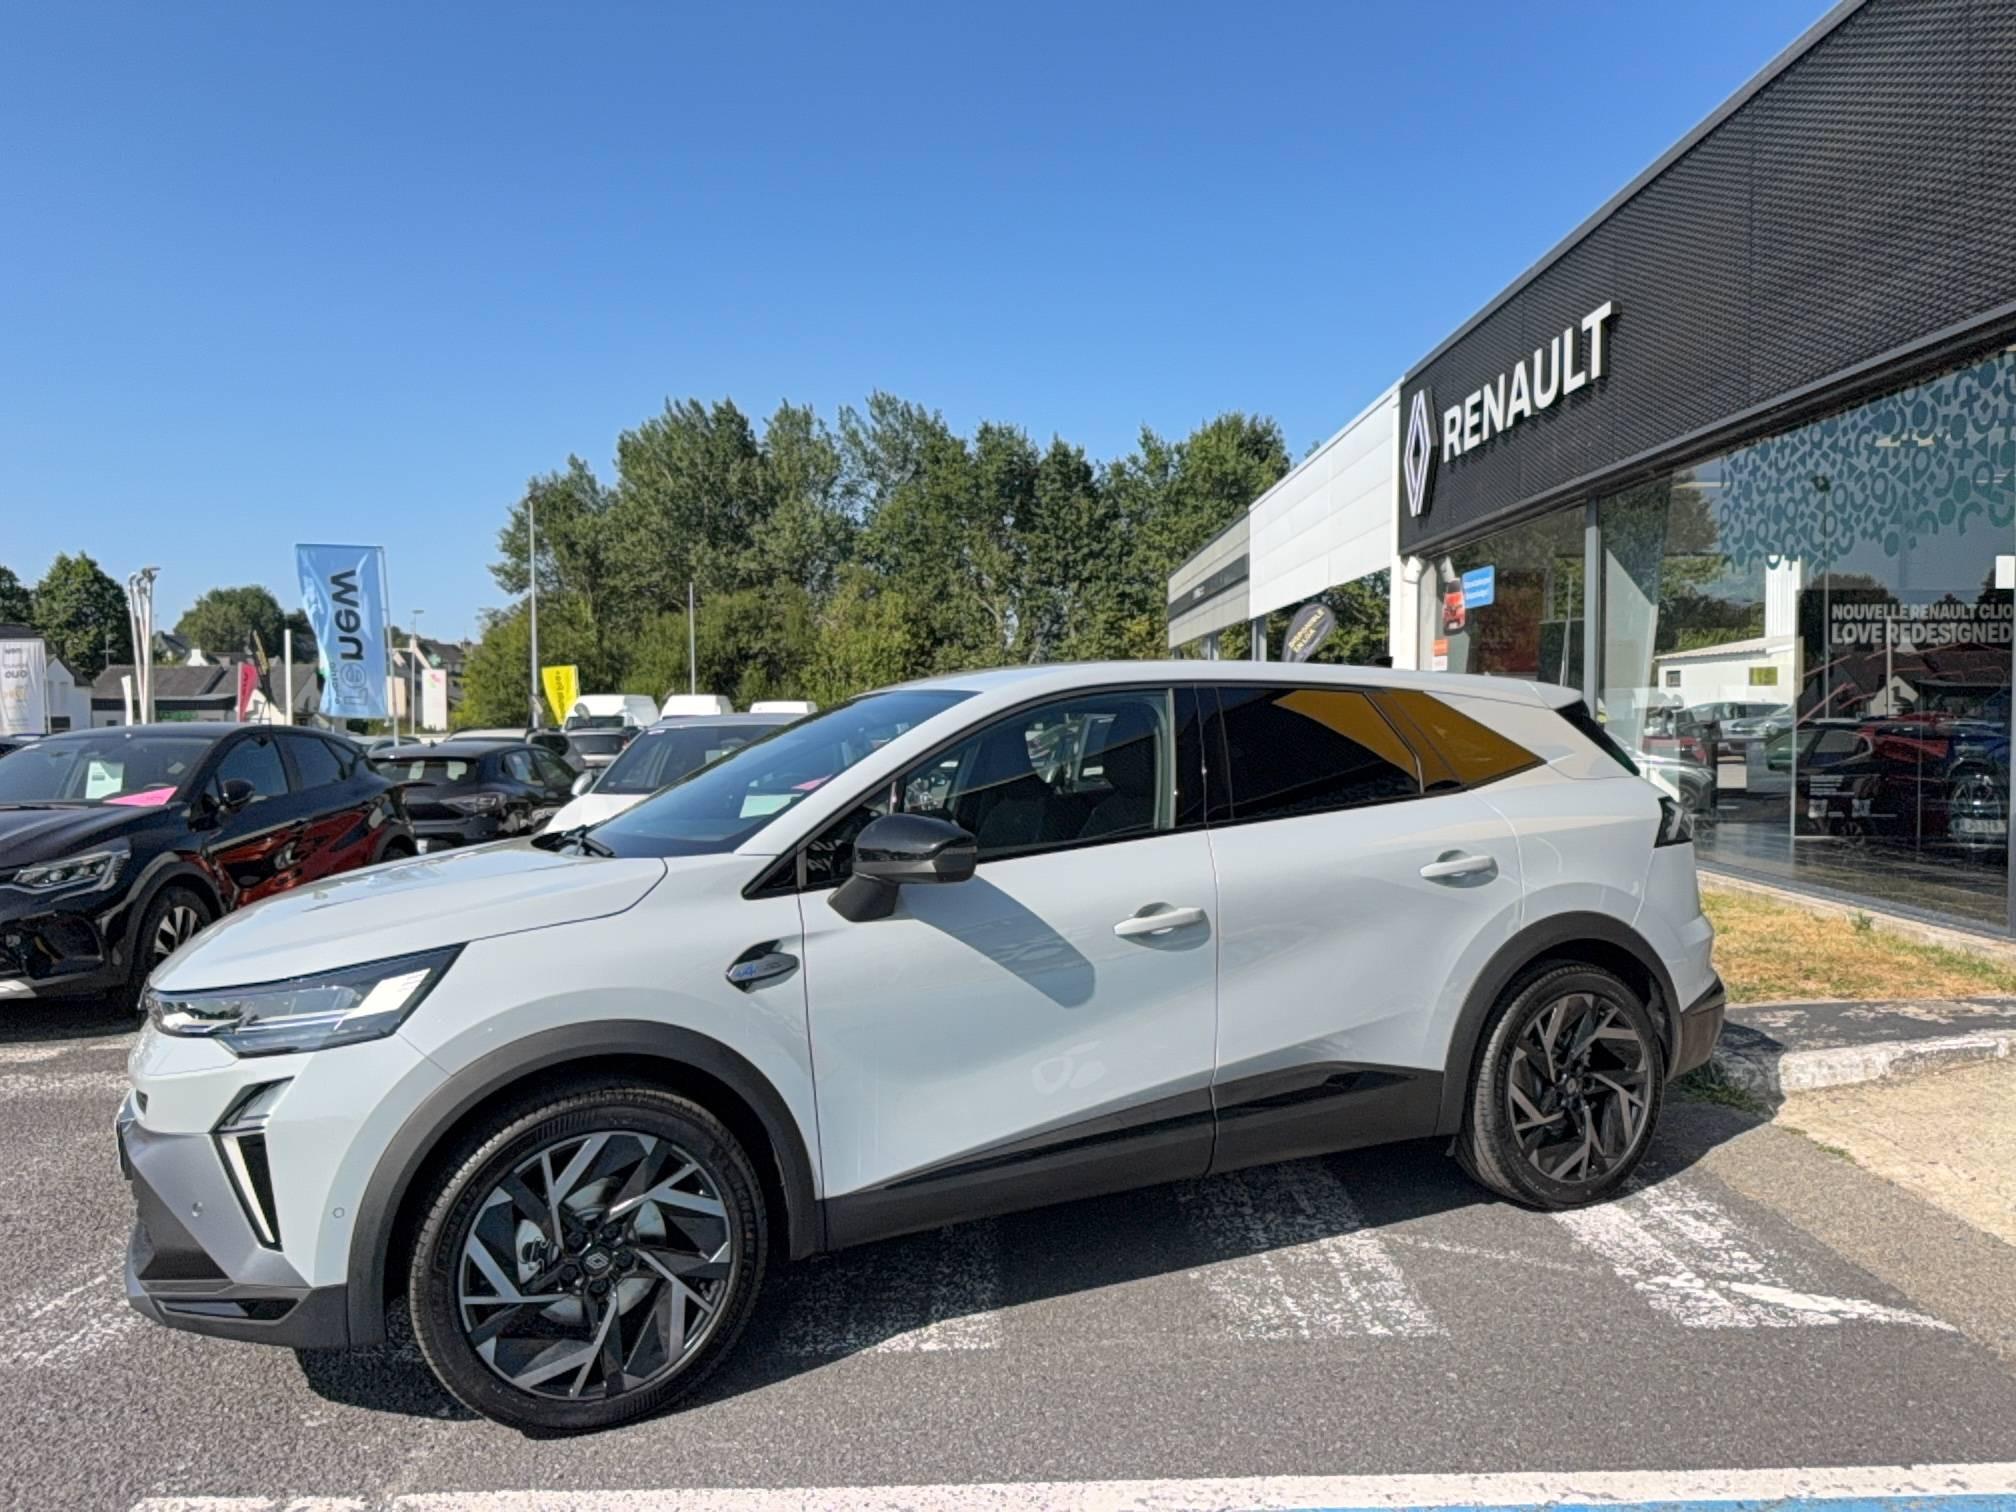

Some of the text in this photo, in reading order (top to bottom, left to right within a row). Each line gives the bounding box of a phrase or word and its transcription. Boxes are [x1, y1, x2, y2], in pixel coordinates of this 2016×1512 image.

[1442, 301, 1614, 463] RENAULT
[1832, 603, 2013, 620] NOUVELLE RENAULT CLIO
[1831, 622, 2013, 644] LOVE REDESIGNED
